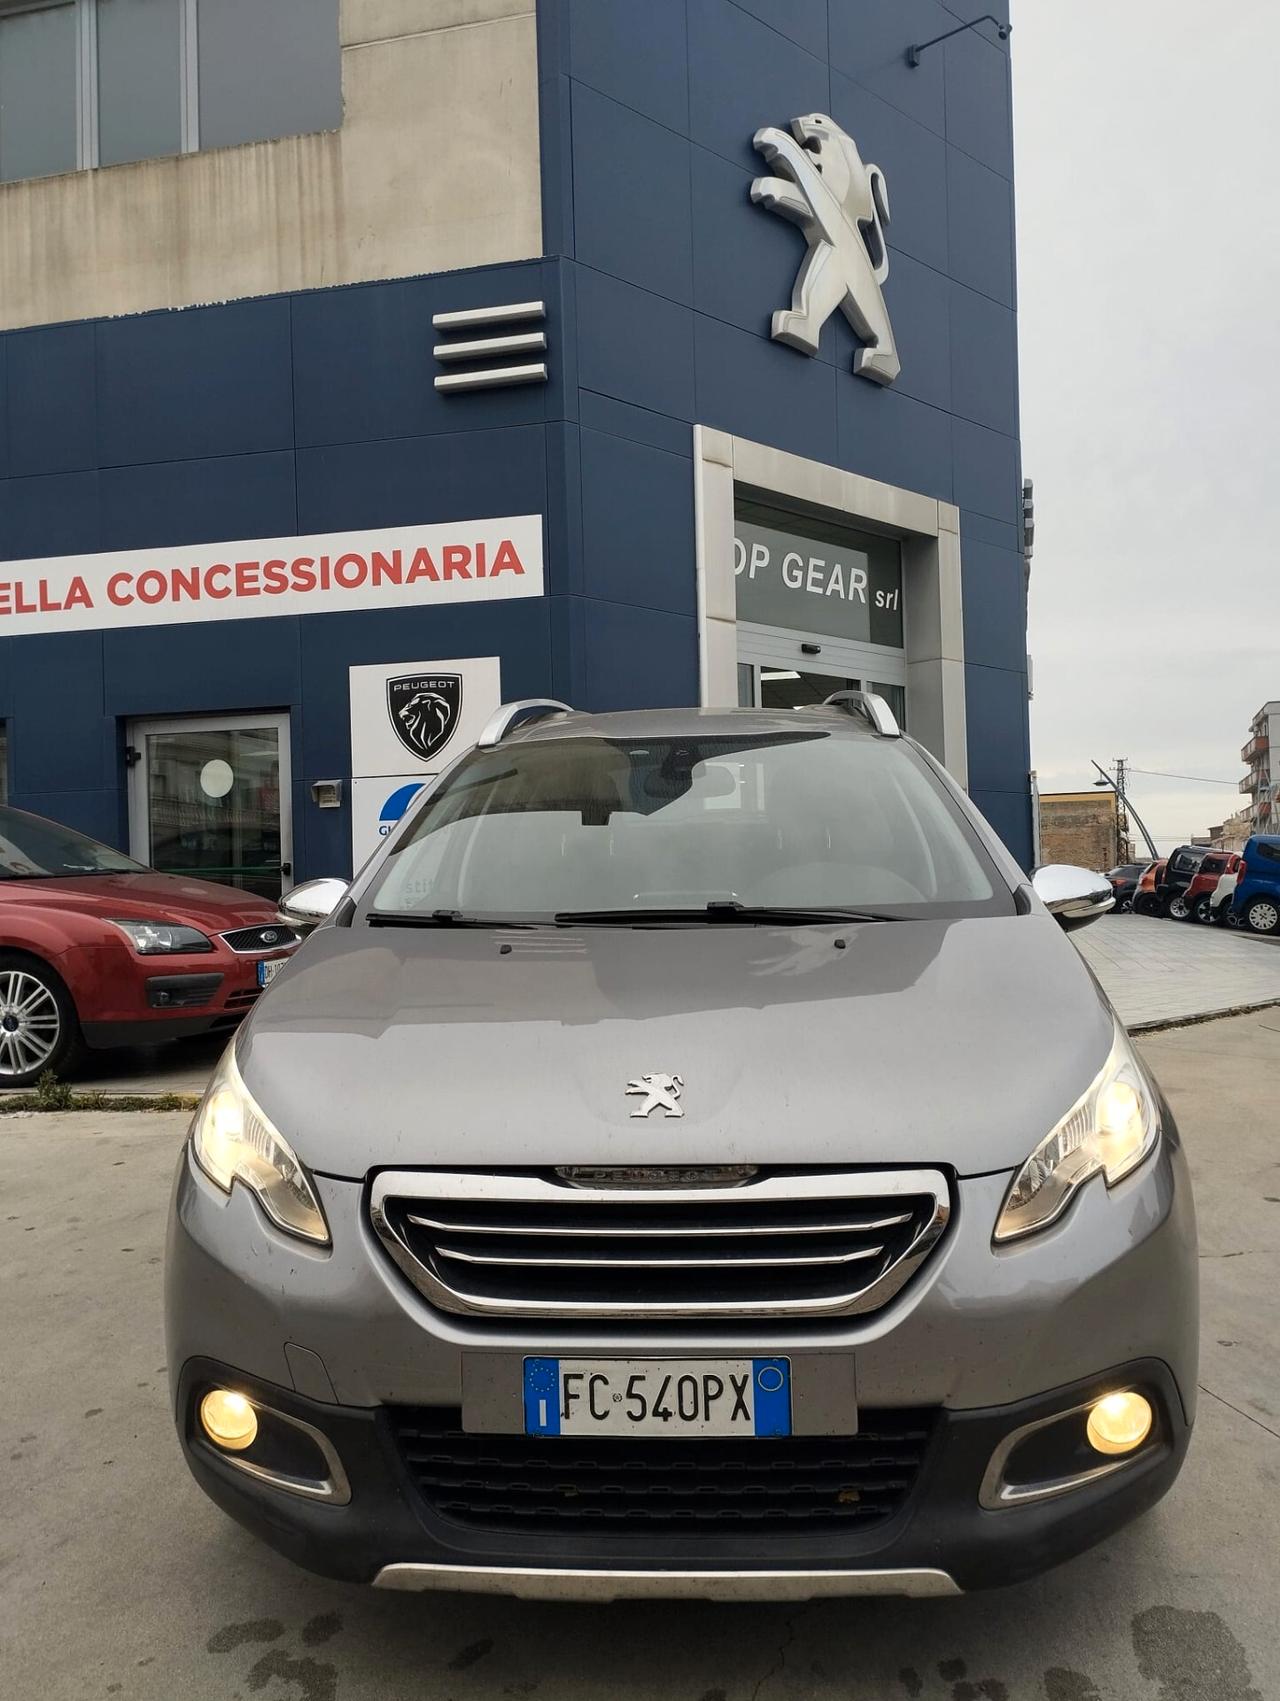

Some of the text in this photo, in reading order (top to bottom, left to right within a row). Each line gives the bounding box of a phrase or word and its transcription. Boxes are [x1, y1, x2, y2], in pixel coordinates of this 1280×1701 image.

[107, 540, 525, 607] CONCESSIONARIA
[782, 552, 867, 604] GEAR
[875, 588, 898, 611] srl
[393, 680, 456, 692] PEUGEOT
